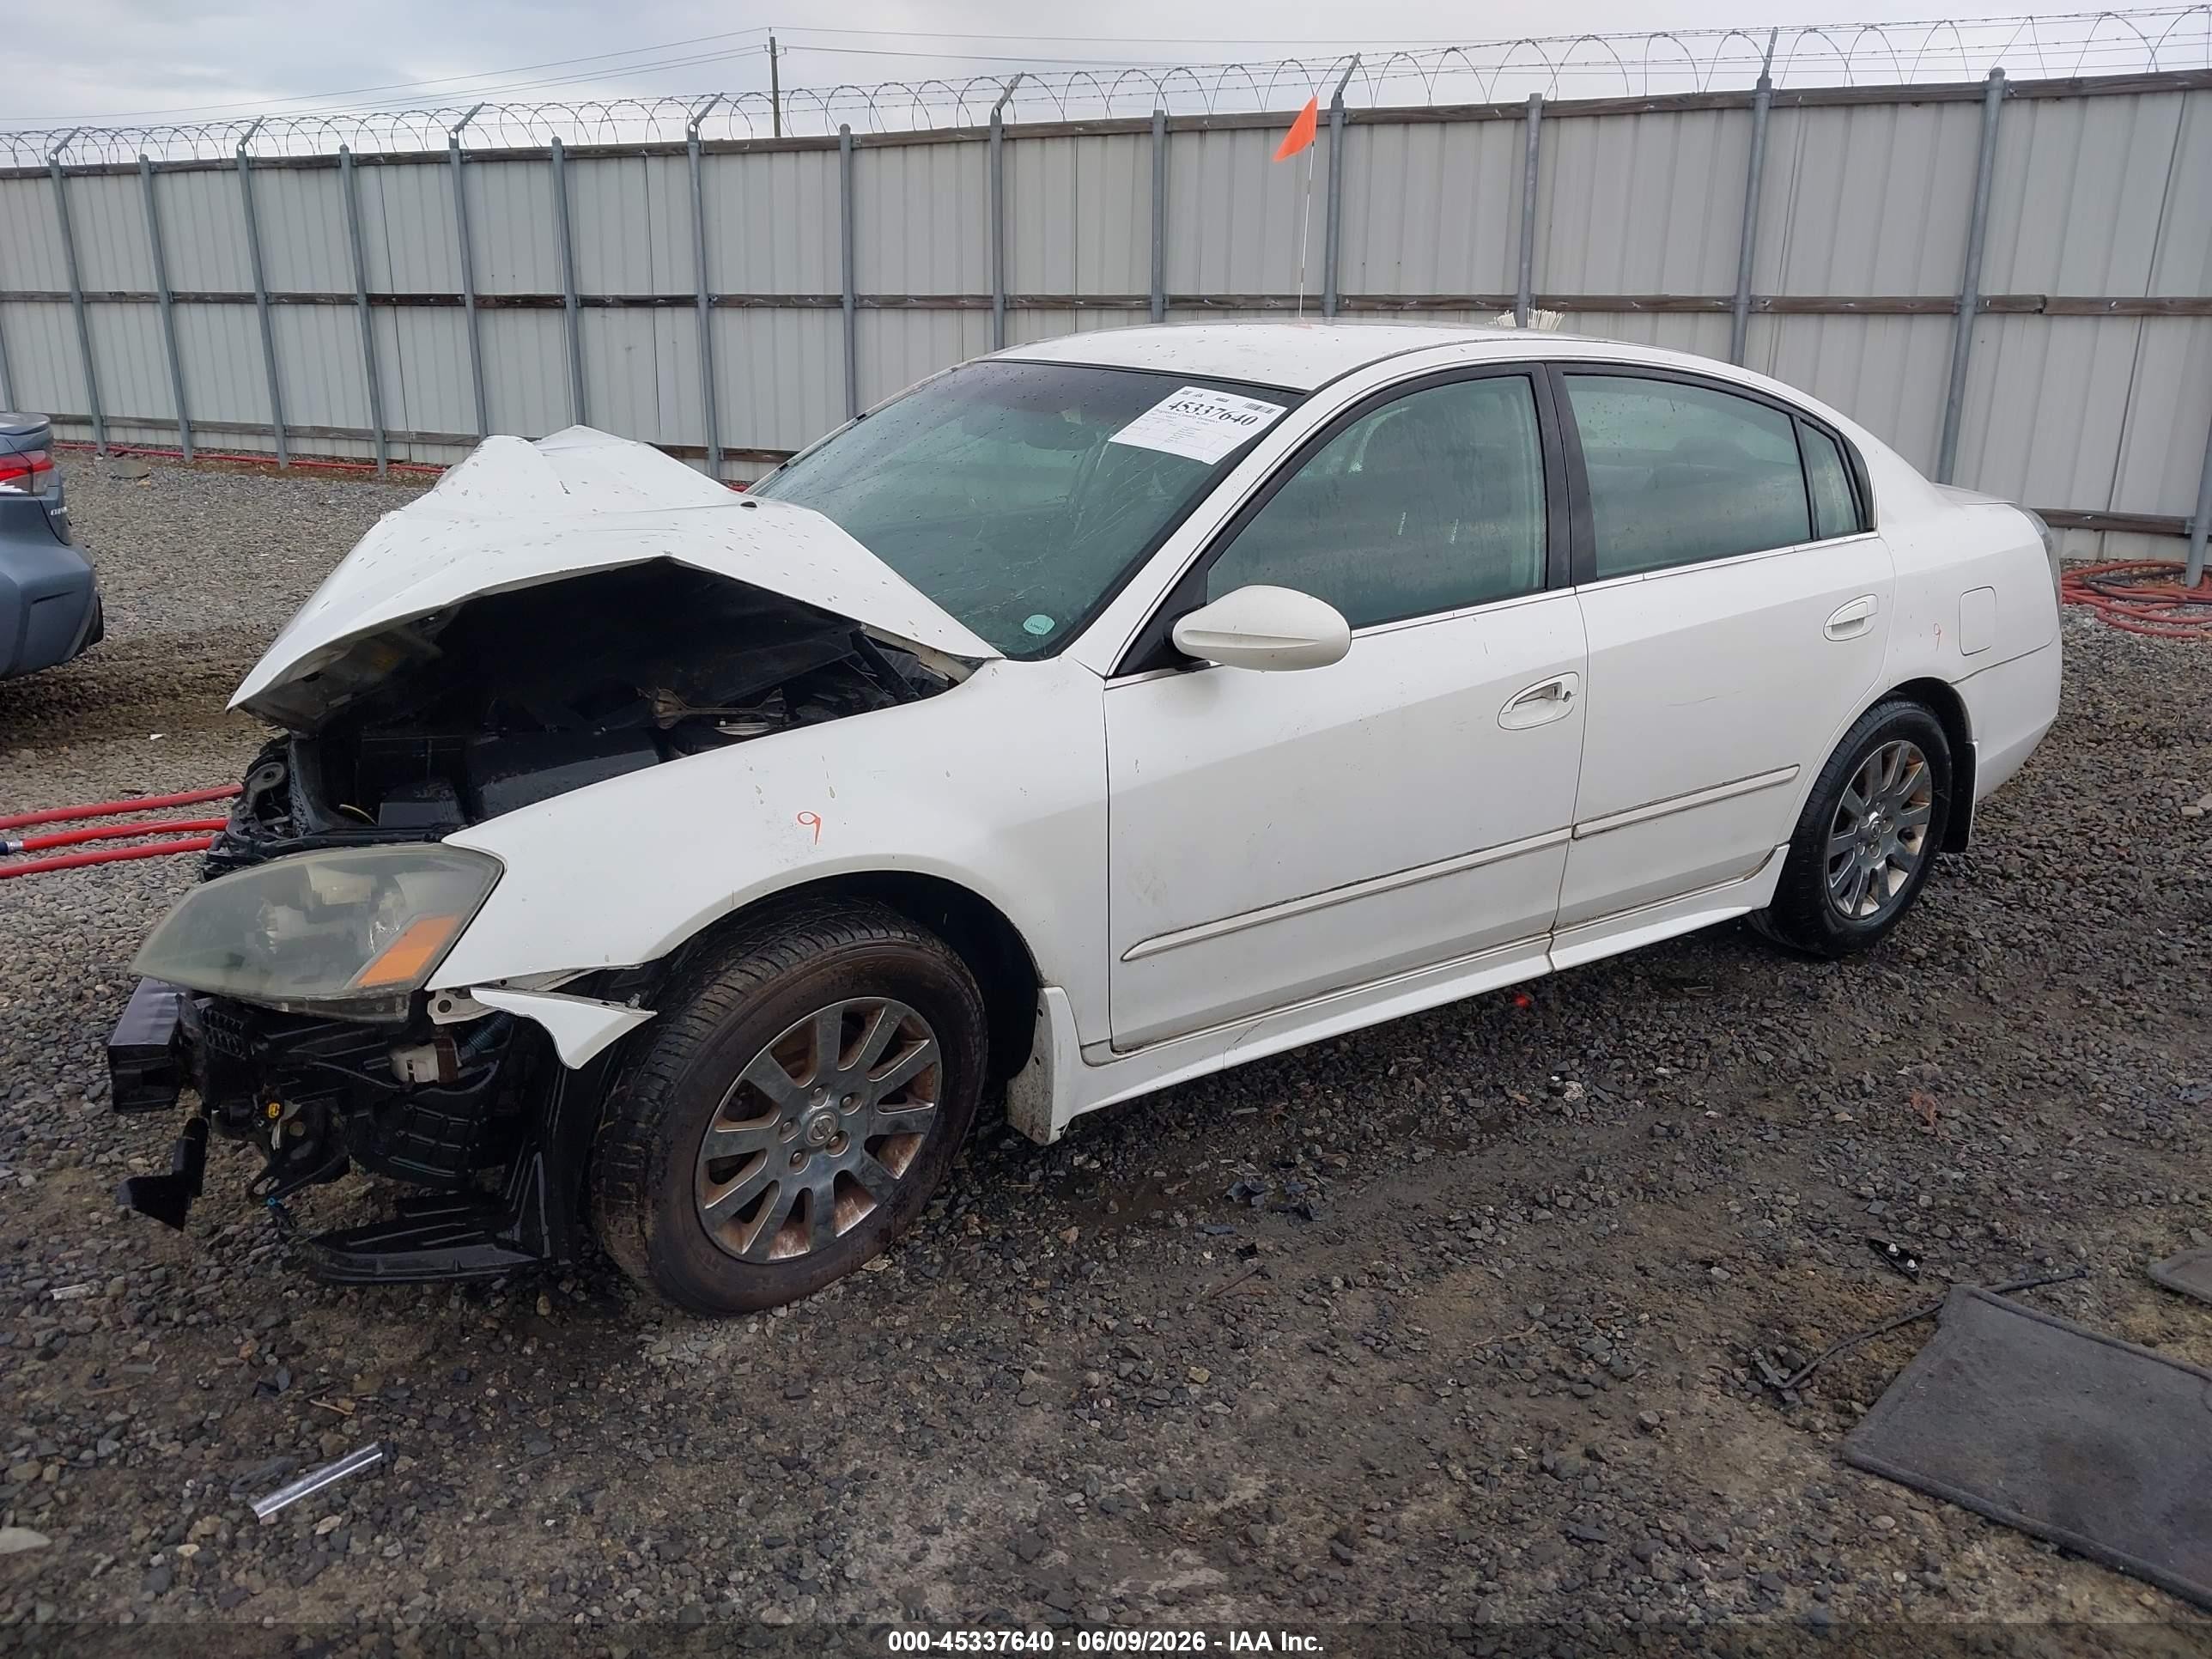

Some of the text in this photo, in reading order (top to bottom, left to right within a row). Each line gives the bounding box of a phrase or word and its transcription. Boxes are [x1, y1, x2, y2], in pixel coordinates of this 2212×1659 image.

[1168, 400, 1258, 426] 45337640
[1933, 623, 1942, 653] 9
[797, 811, 821, 845] 9
